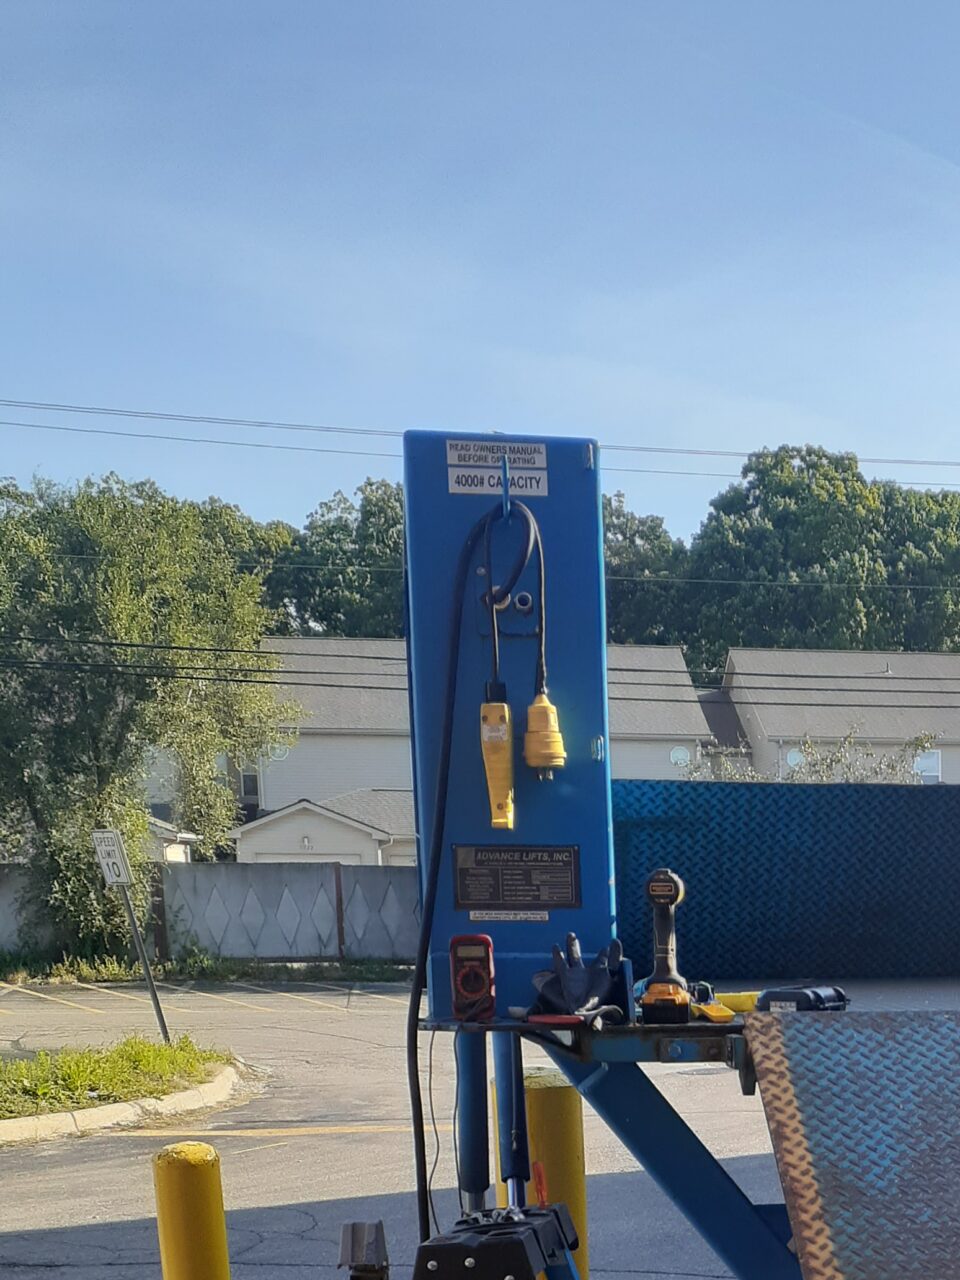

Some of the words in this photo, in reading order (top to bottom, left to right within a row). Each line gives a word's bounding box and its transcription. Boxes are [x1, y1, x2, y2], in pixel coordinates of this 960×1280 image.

[473, 443, 507, 455] OWNERS
[508, 445, 543, 455] MANUAL
[457, 453, 489, 464] BEFORE
[490, 455, 536, 465] OPRATING
[454, 474, 484, 487] 4000#
[487, 475, 541, 489] CAACITY
[95, 836, 115, 847] SPEED
[100, 849, 117, 859] LIMIT
[476, 851, 521, 861] ADVANCE
[522, 852, 551, 862] LIFTS,
[552, 852, 572, 861] INC.
[106, 861, 121, 880] 10
